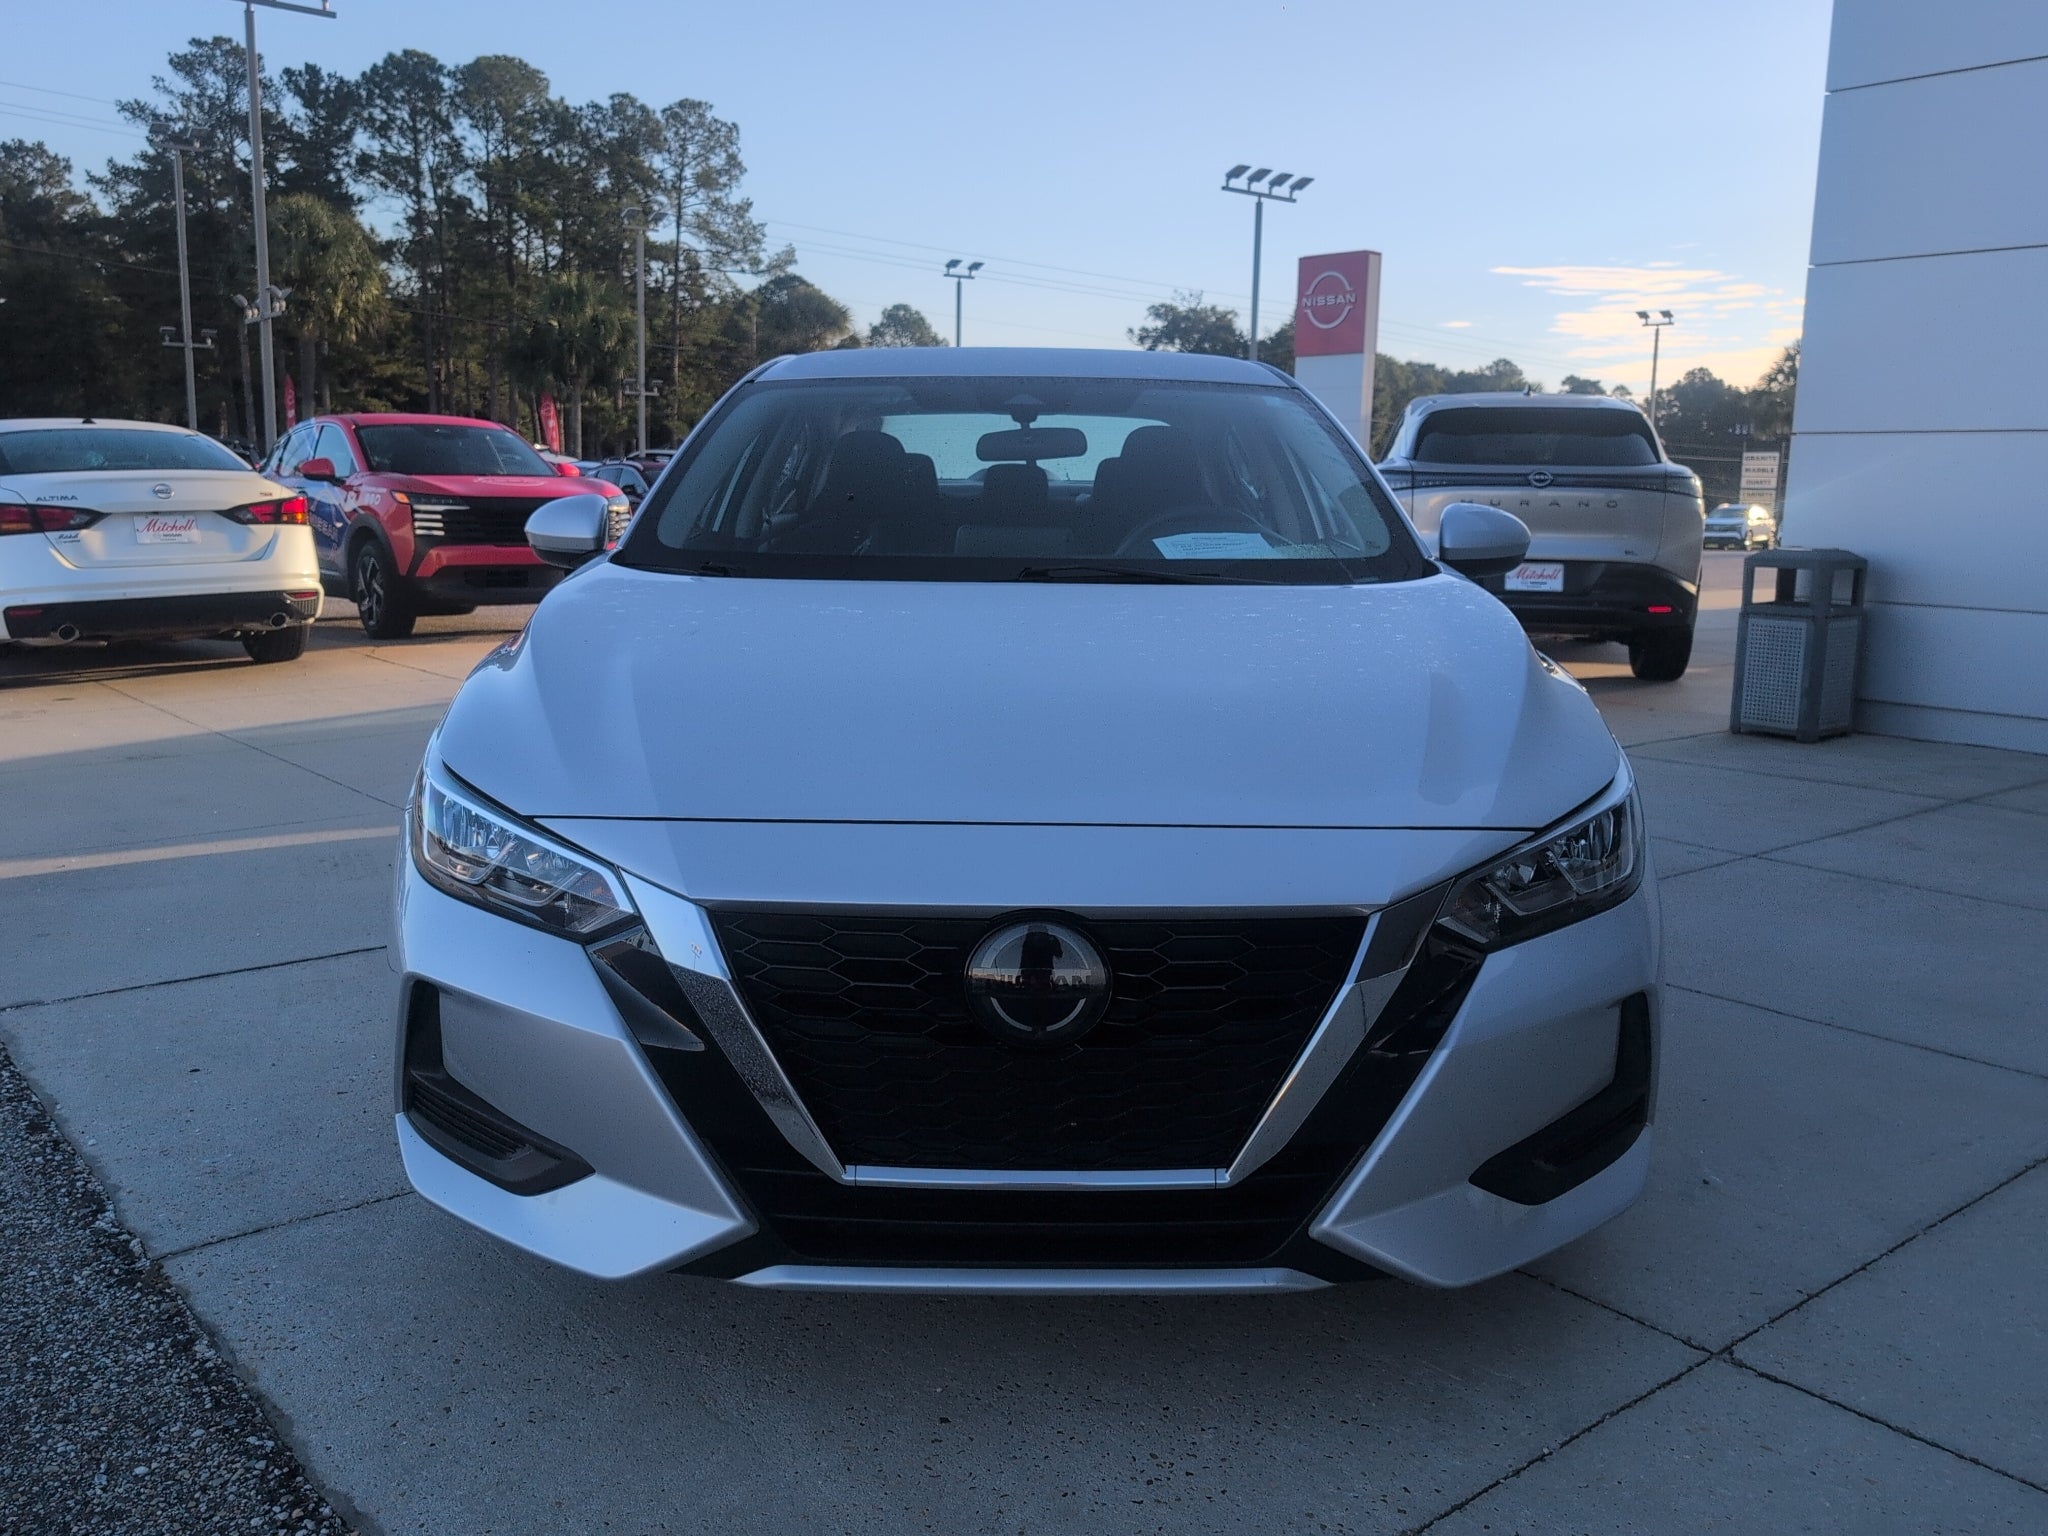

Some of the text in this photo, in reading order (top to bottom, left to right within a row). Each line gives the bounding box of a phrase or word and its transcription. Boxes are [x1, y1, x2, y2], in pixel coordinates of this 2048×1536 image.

[1302, 293, 1356, 308] NISSAN
[140, 518, 195, 533] Mitchell
[1514, 567, 1562, 580] Mitchell
